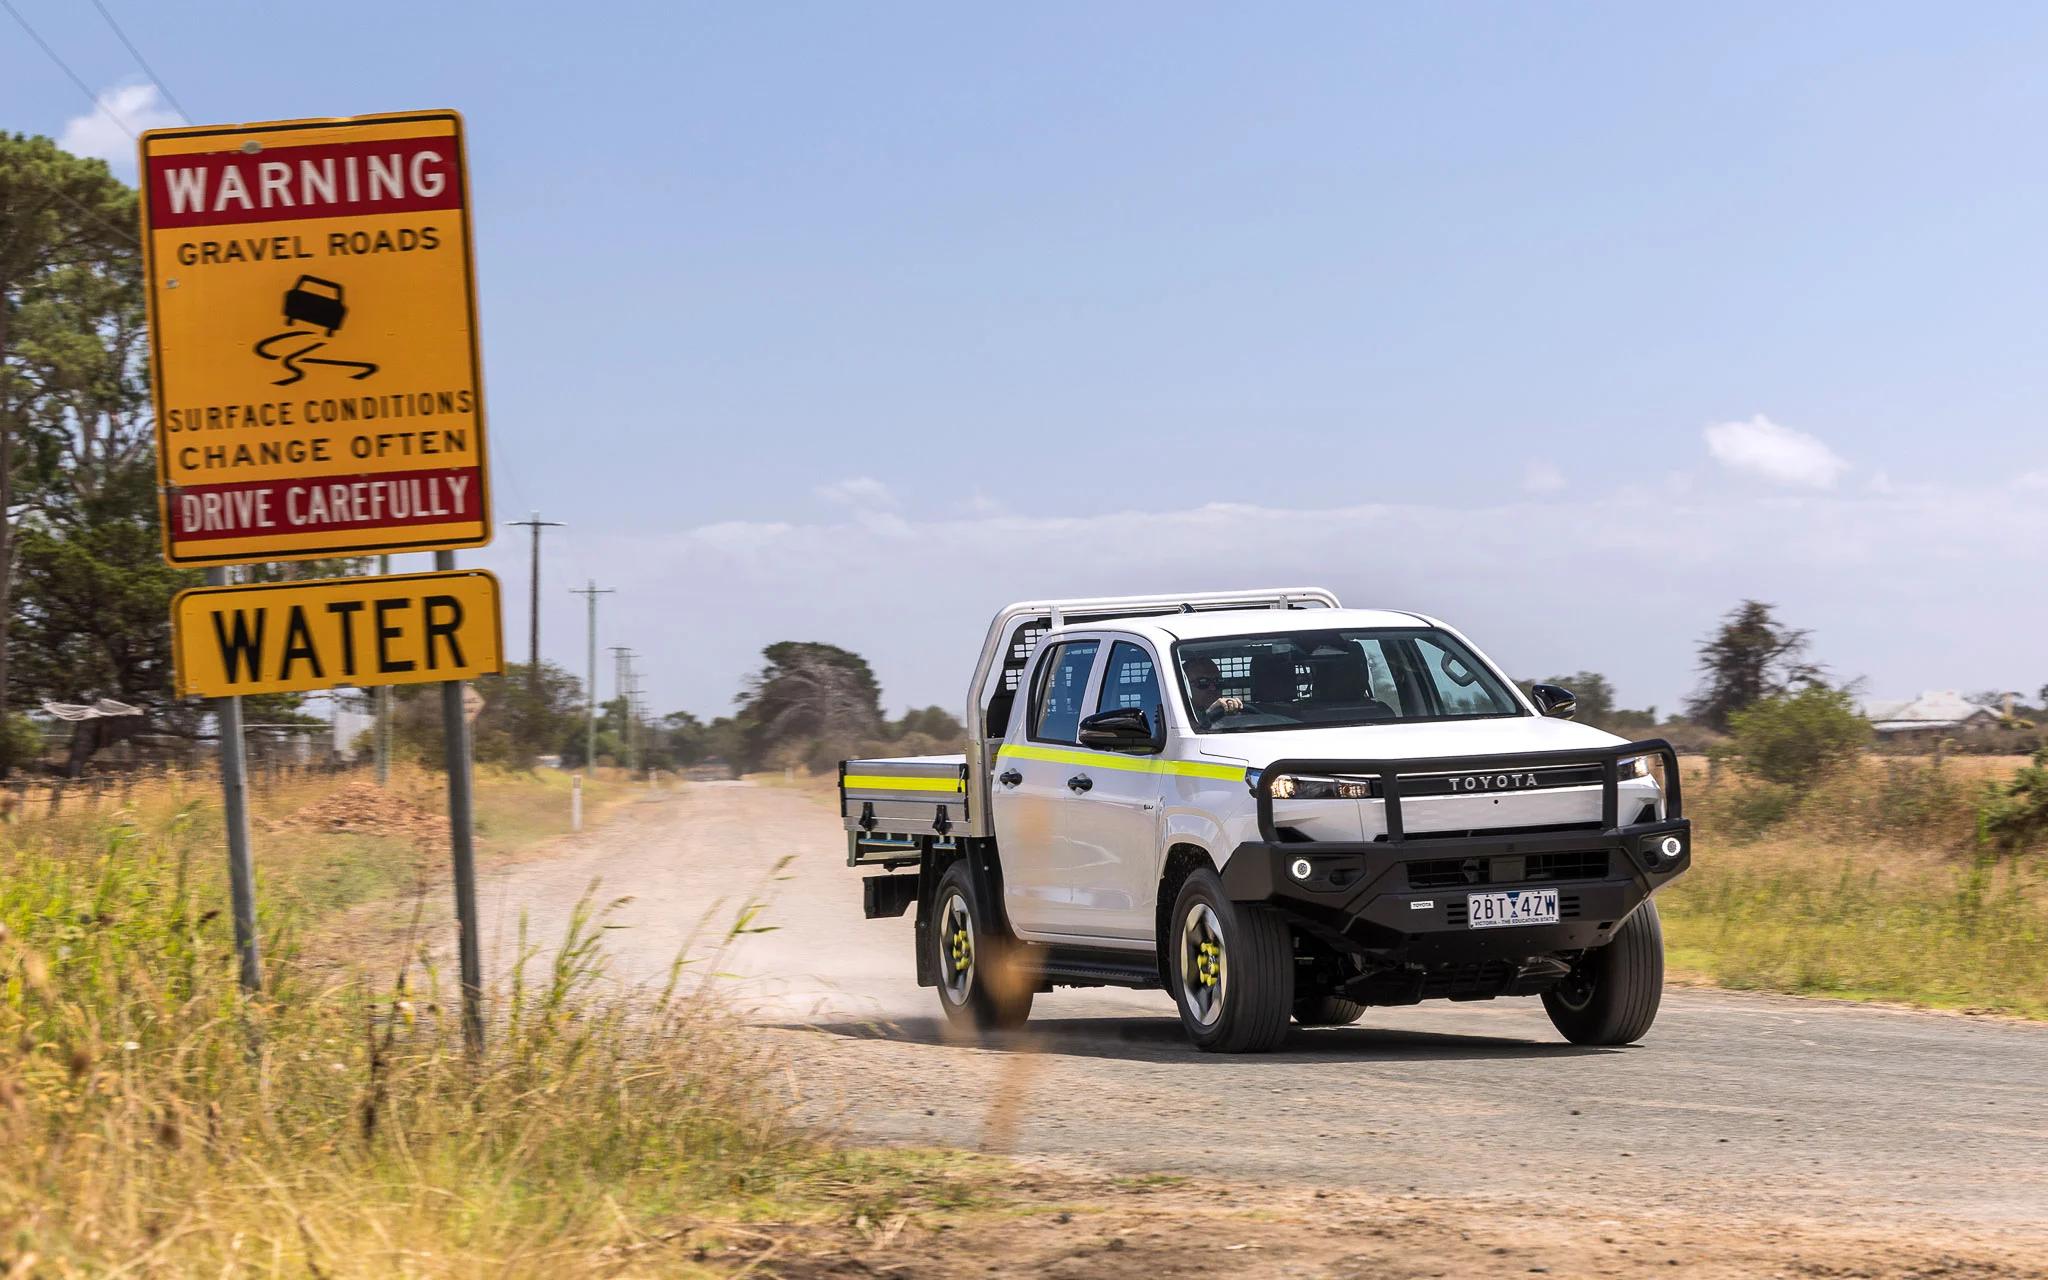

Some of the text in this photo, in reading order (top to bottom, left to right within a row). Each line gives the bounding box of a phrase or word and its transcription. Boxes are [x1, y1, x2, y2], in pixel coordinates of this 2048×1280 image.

[164, 150, 446, 214] WARNING
[177, 226, 441, 266] GRAVEL ROADS
[167, 390, 473, 432] SURFACE CONDITIONS
[179, 429, 467, 470] CHANGE OFTEN
[181, 476, 470, 533] DRIVE CAREFULLY
[210, 594, 468, 684] WATER
[1449, 773, 1538, 791] TOYOTA
[1472, 895, 1556, 919] 2BT 4ZW
